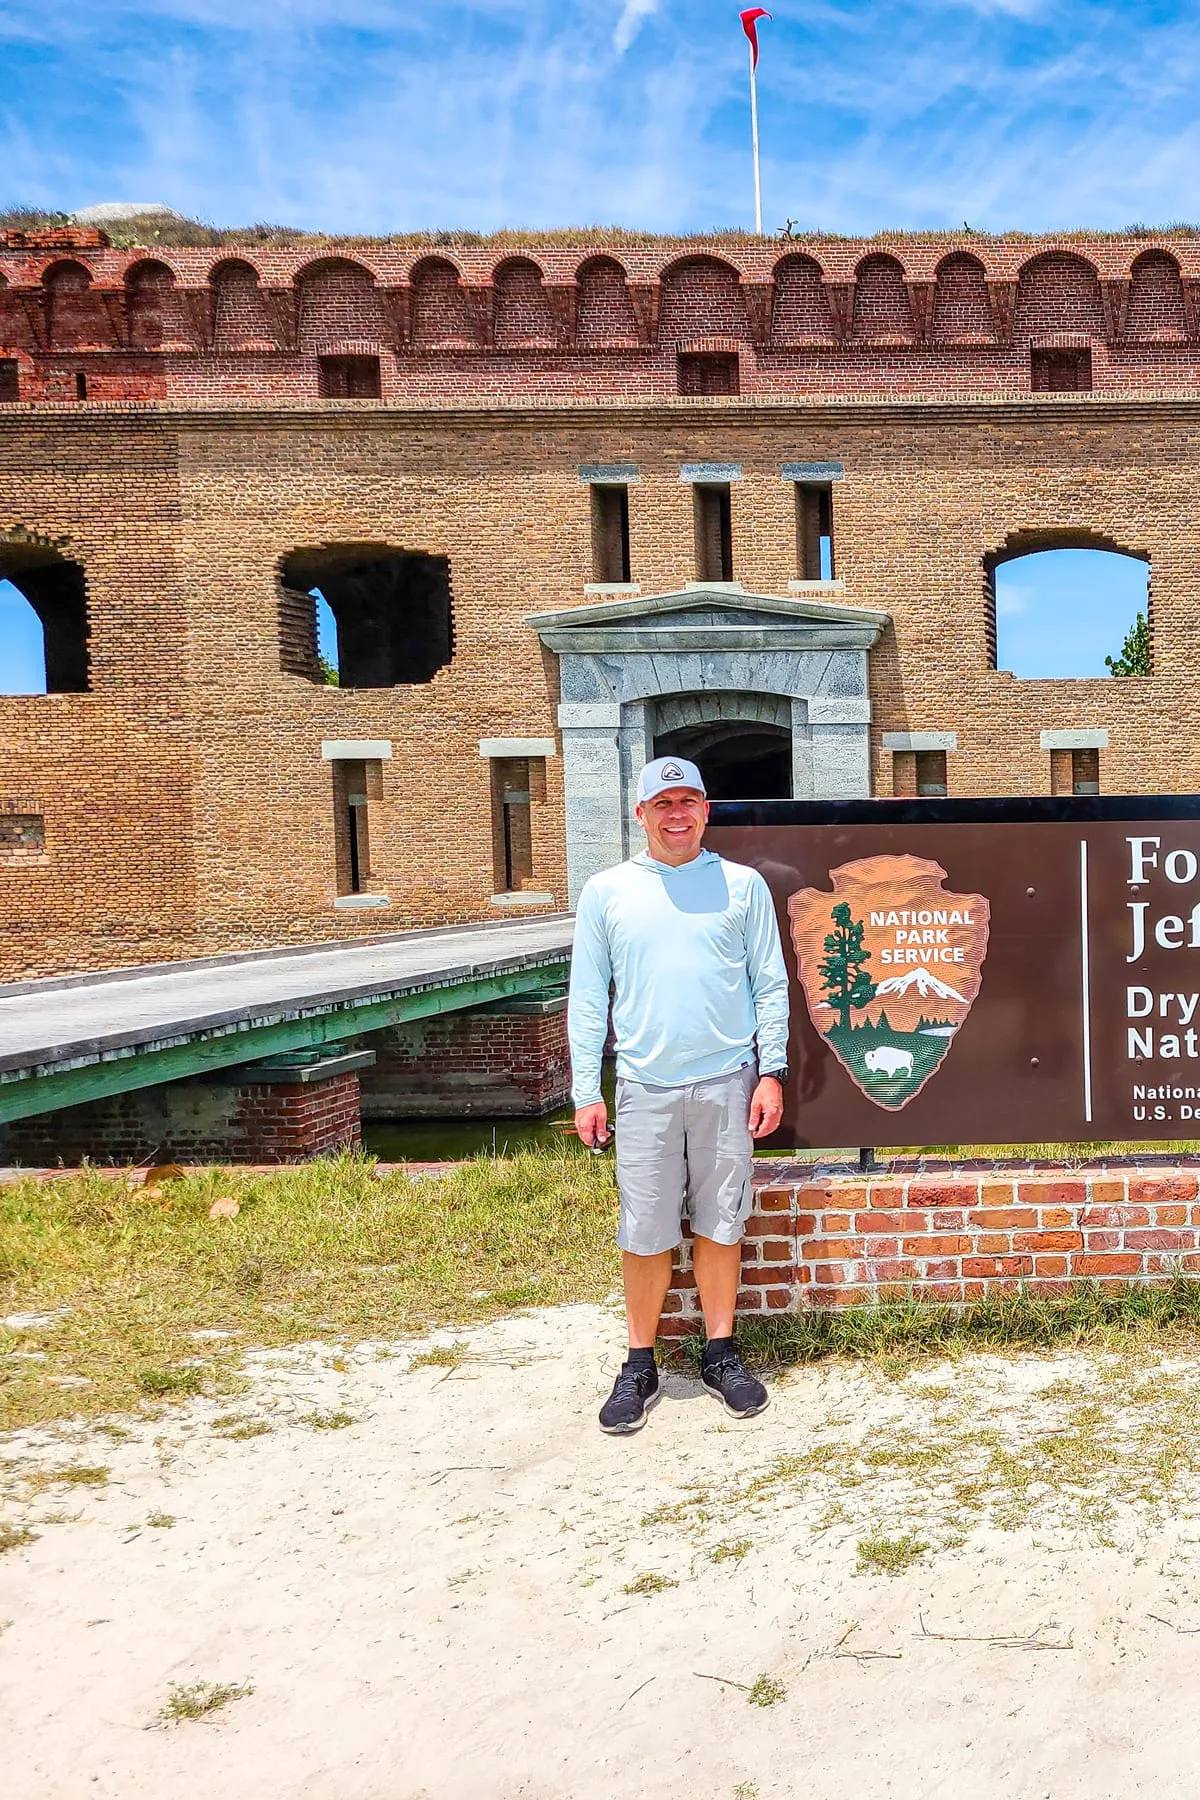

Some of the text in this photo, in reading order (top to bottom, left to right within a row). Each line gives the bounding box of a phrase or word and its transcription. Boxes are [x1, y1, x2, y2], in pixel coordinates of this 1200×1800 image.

[870, 910, 975, 927] NATIONAL
[895, 928, 949, 945] PARK
[880, 947, 965, 964] SERVICE
[1126, 986, 1200, 1025] Dry
[1133, 1105, 1173, 1121] U.S.
